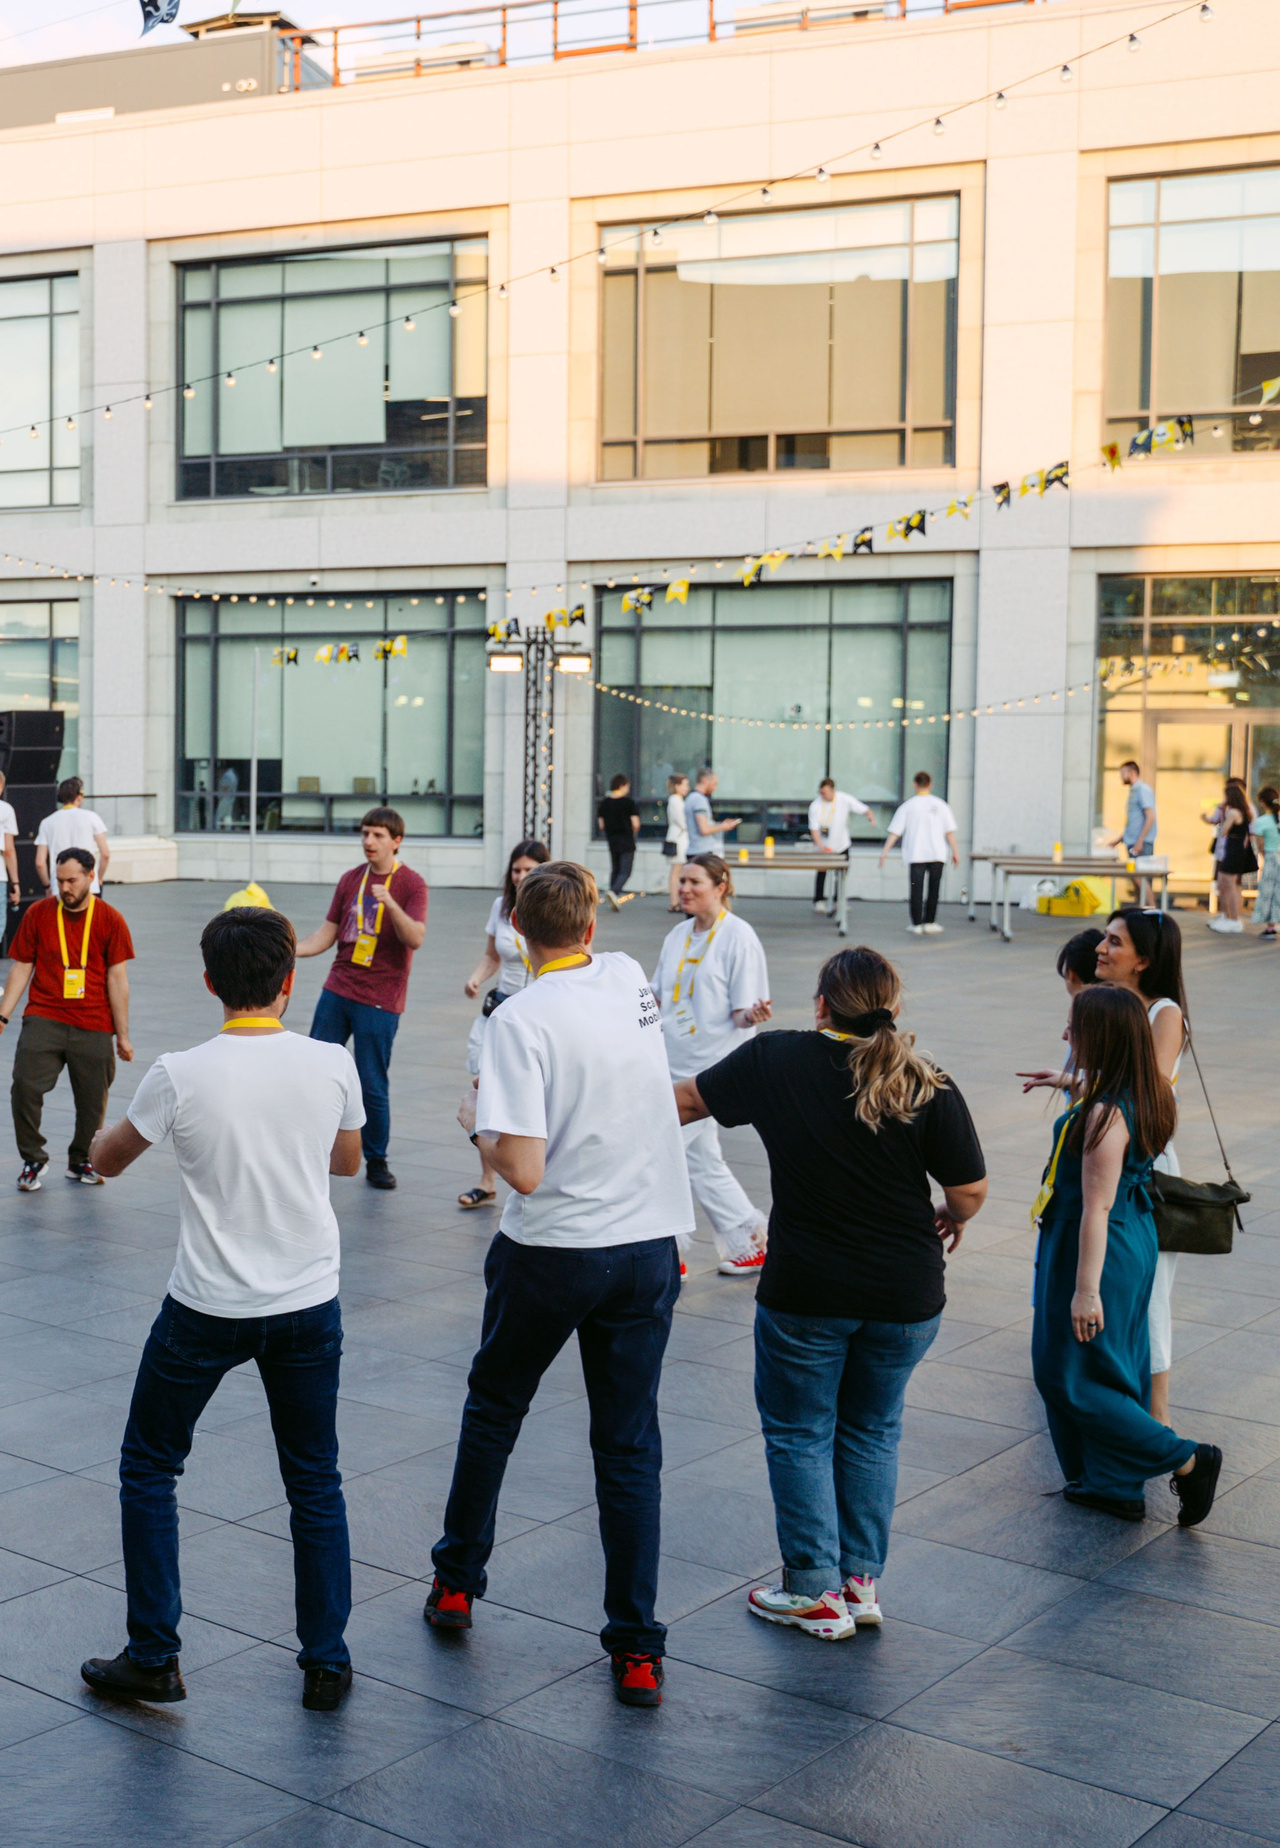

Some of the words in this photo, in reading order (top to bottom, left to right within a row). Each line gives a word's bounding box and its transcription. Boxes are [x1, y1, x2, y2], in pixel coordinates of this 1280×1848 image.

[638, 988, 650, 998] Ja
[640, 1000, 656, 1012] Sca
[638, 1012, 660, 1029] Mob
